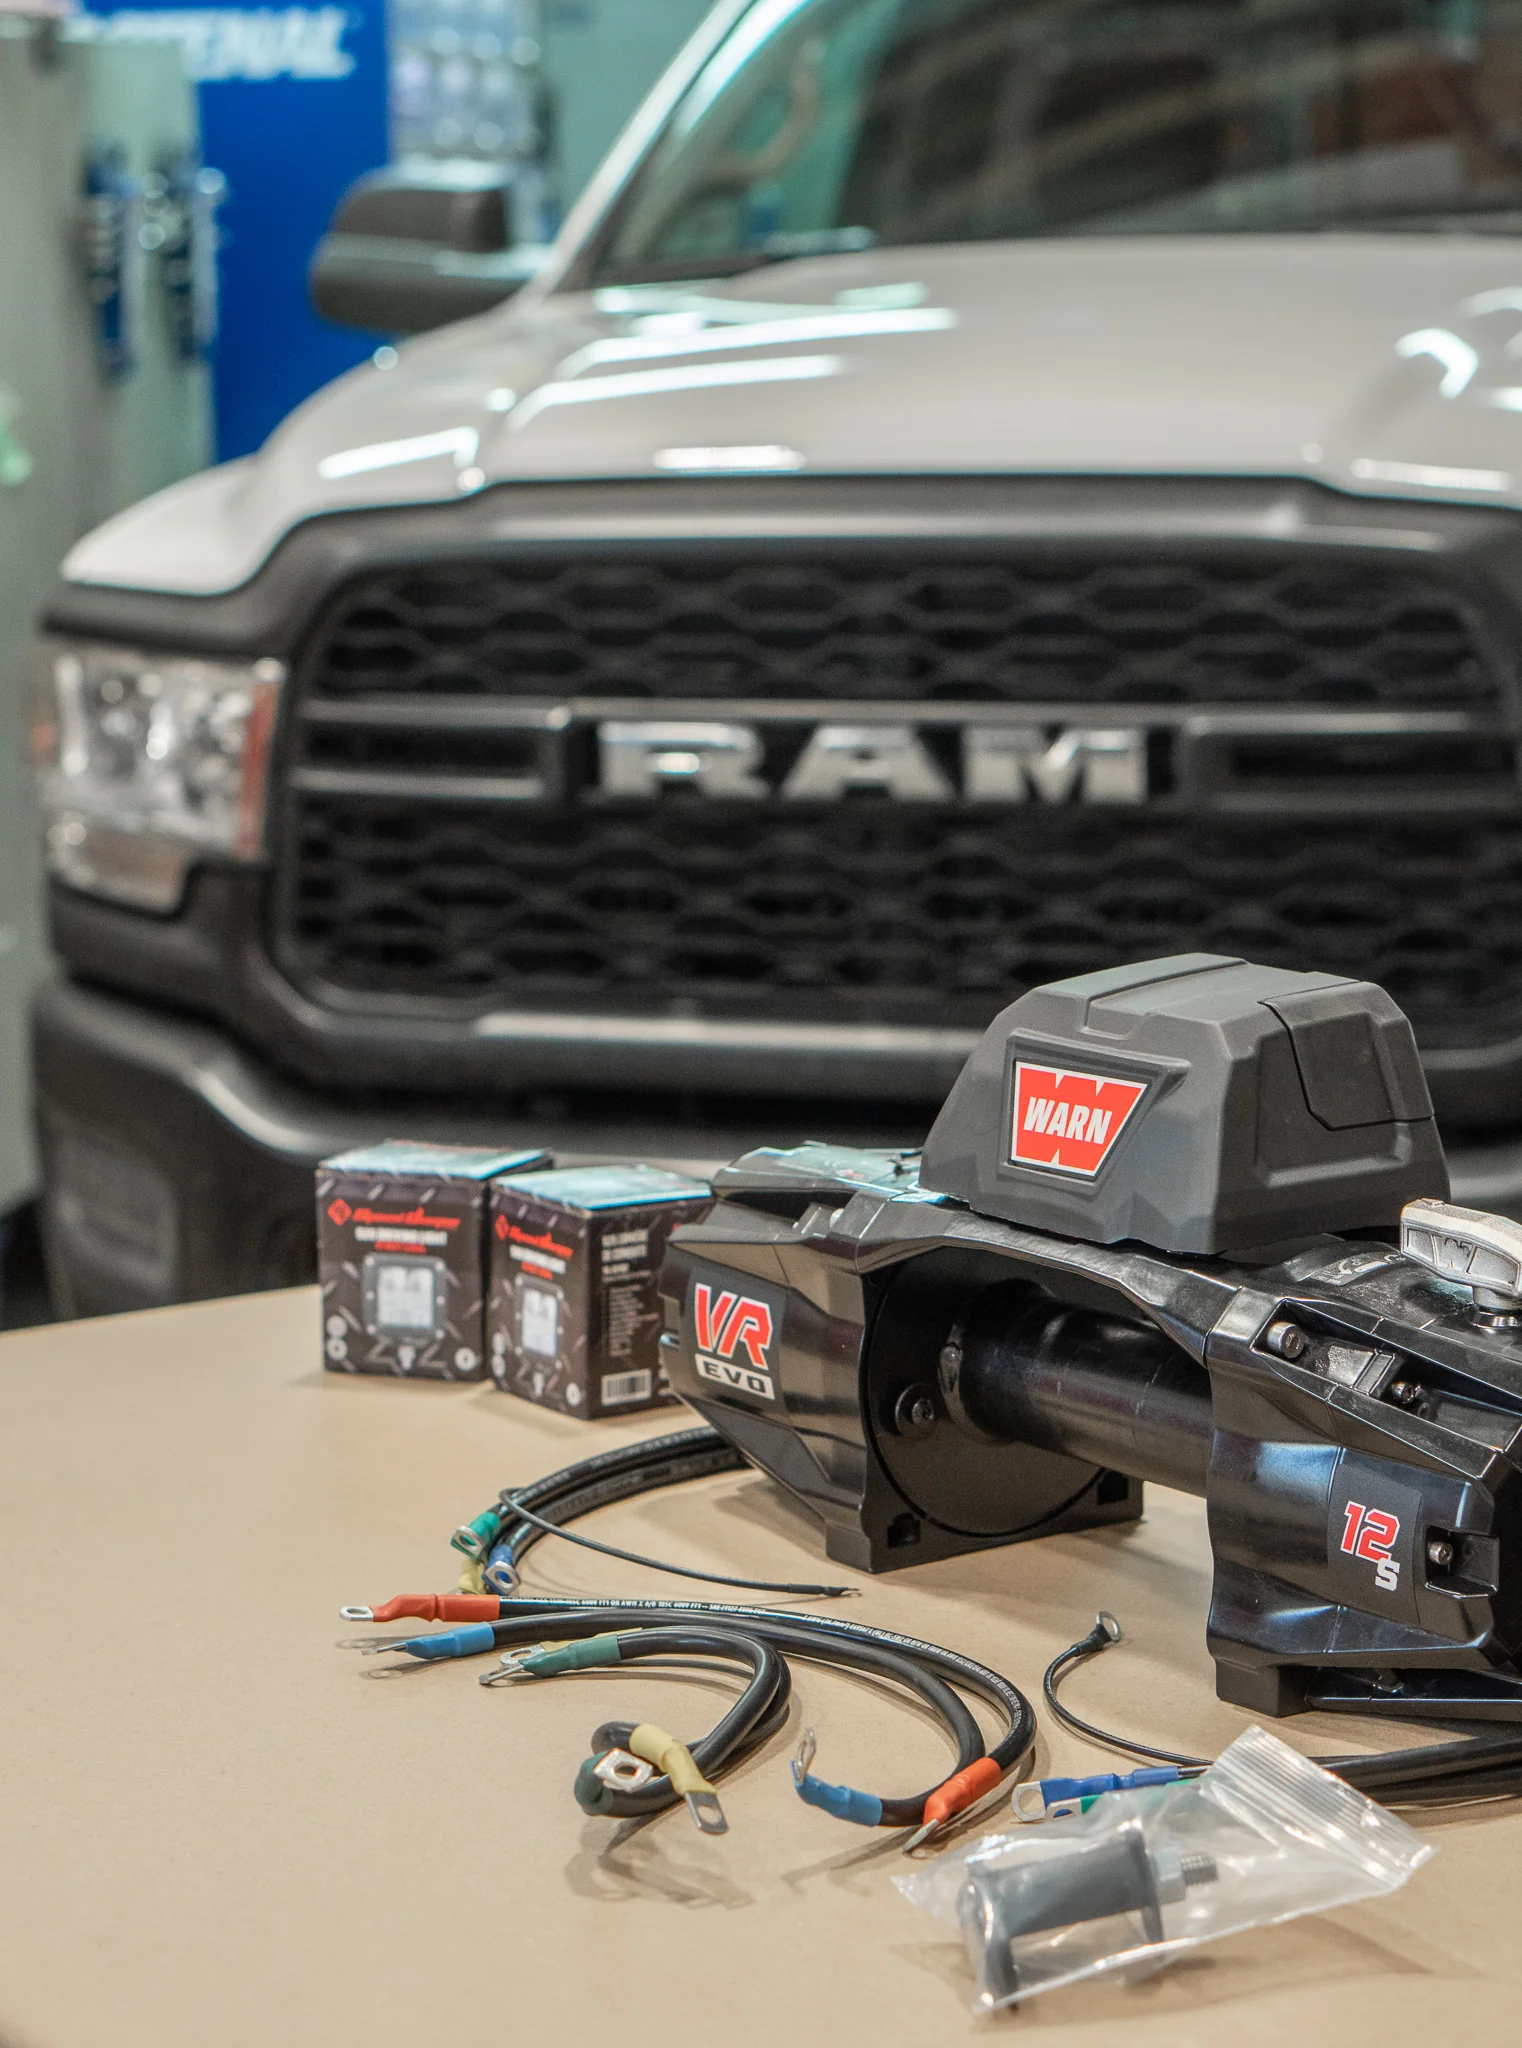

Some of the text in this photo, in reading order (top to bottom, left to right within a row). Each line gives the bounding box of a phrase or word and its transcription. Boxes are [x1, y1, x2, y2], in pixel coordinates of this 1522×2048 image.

[600, 722, 1146, 799] RAM
[1023, 1096, 1112, 1144] WARN
[694, 1283, 773, 1371] VR
[703, 1361, 767, 1393] EVO
[1340, 1500, 1400, 1564] 12
